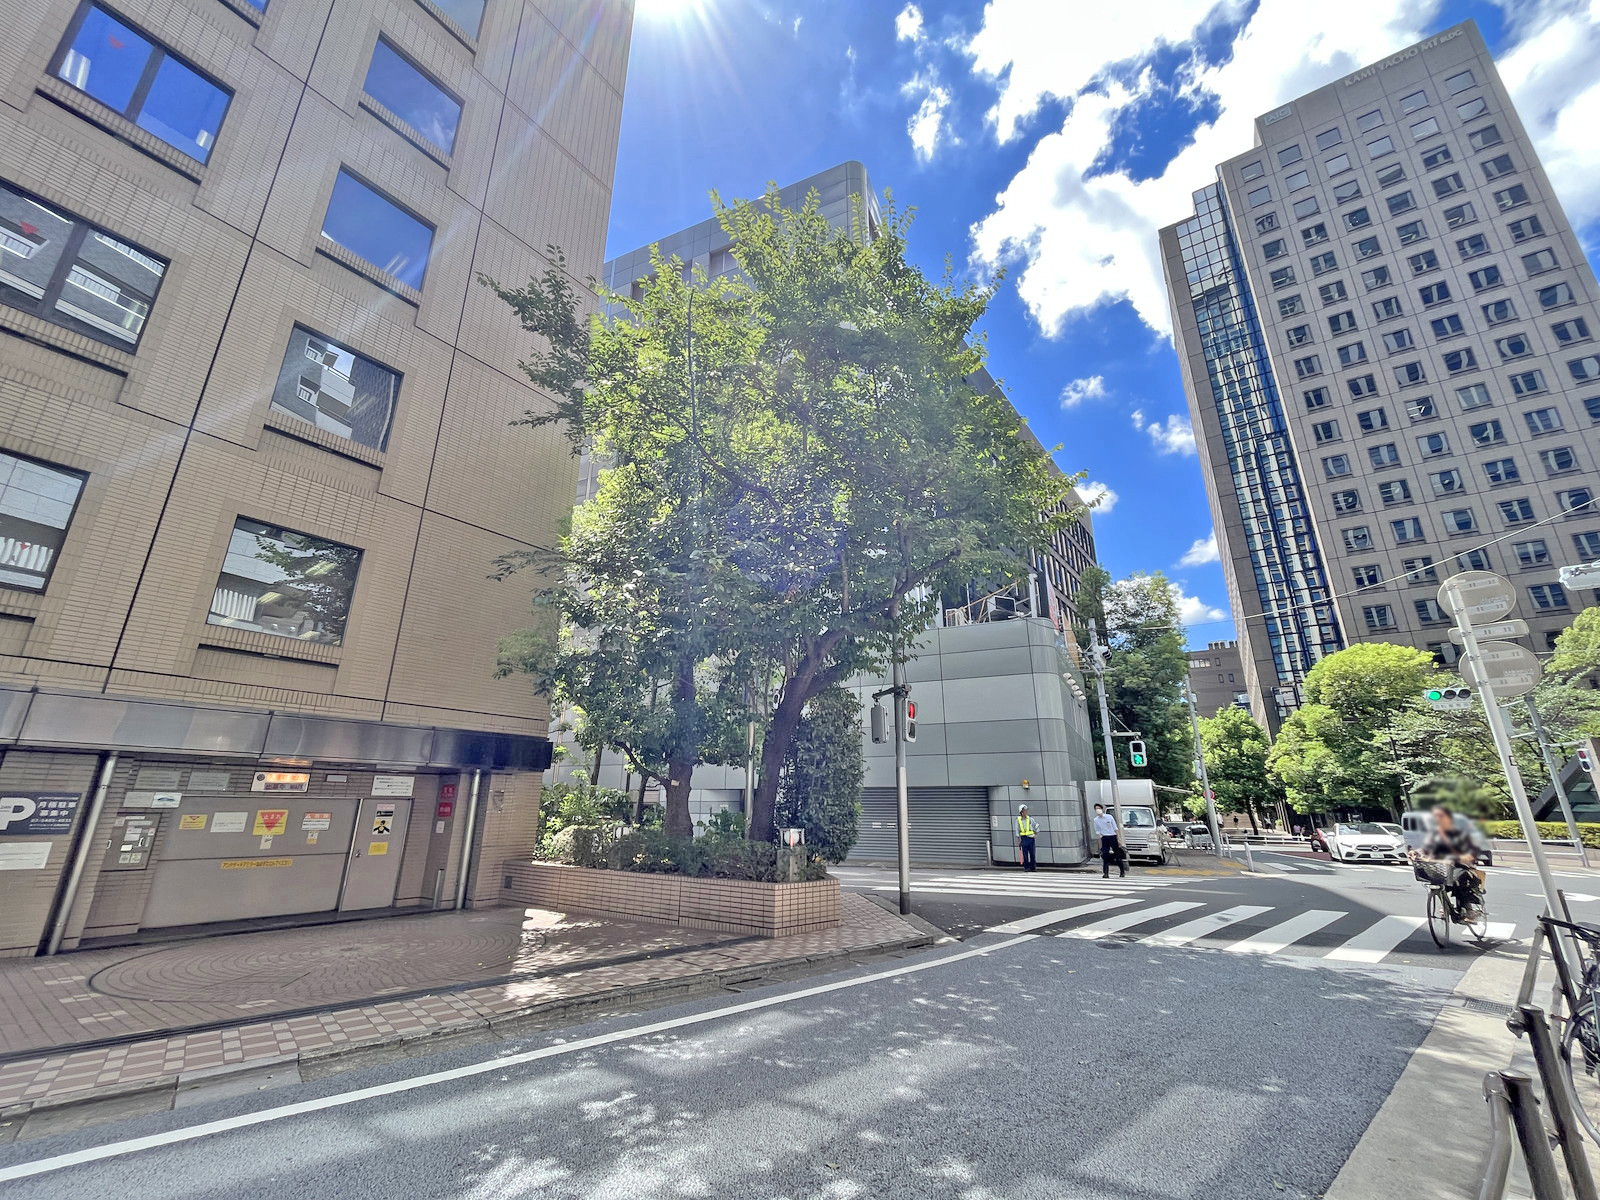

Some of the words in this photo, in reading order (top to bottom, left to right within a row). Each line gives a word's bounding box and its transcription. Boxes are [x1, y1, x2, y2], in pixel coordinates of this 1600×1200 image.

[0, 797, 36, 830] P
[40, 809, 69, 817] 募集中
